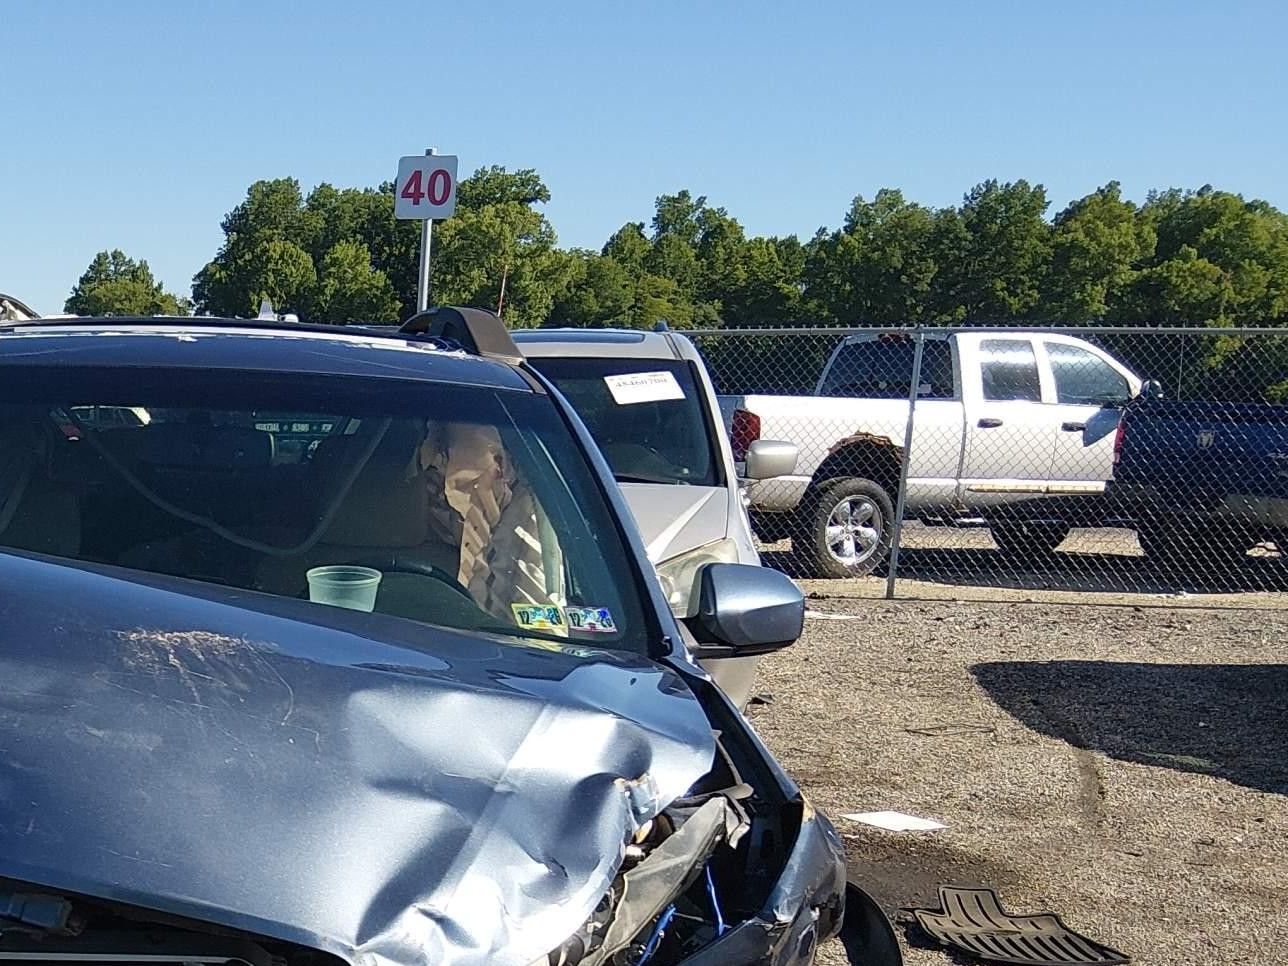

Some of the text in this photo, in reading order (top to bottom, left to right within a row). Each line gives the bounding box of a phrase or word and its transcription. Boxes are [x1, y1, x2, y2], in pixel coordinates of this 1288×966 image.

[401, 169, 451, 206] 40
[517, 610, 532, 625] 12
[568, 612, 583, 627] 12
